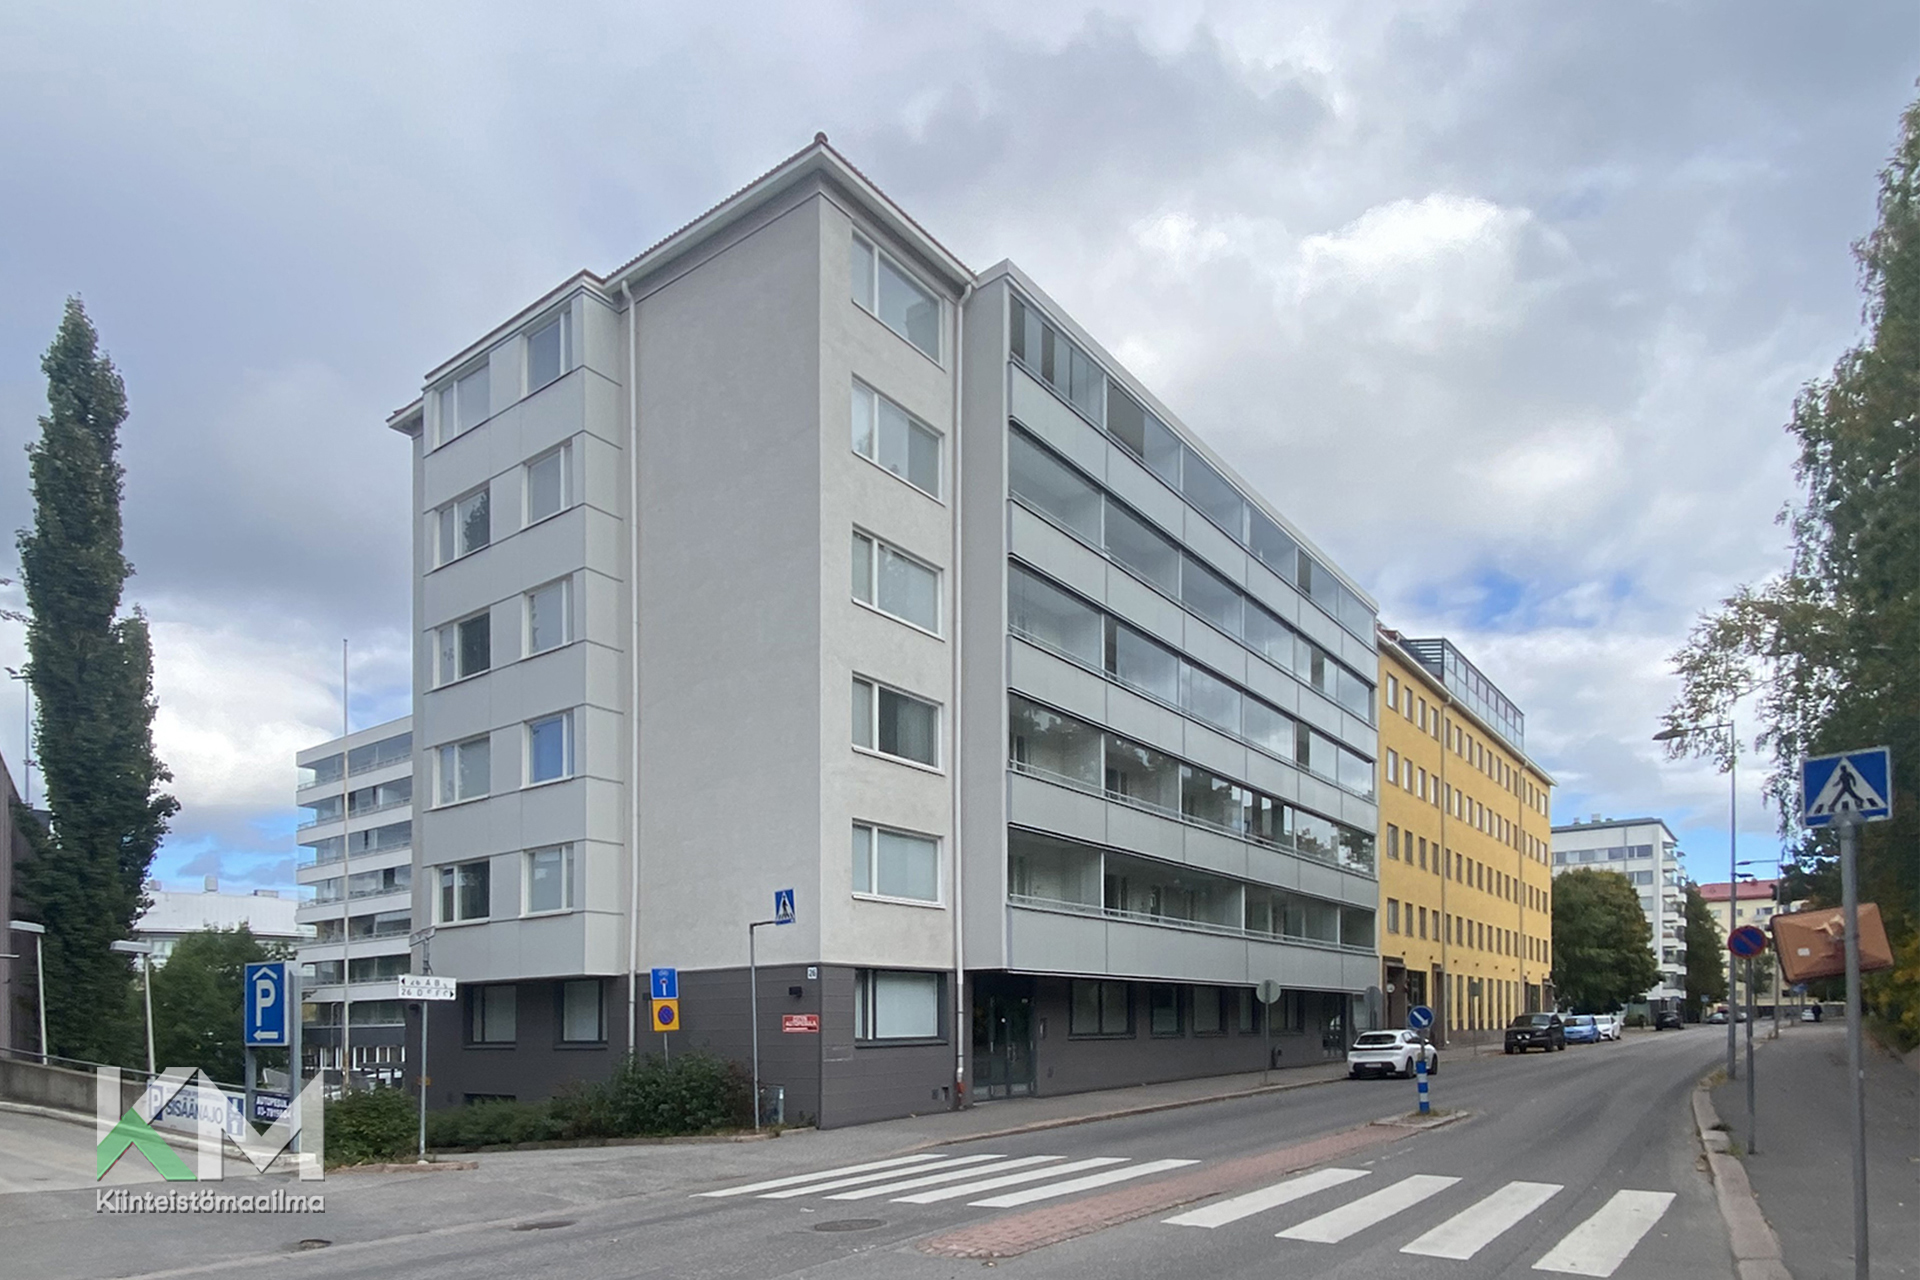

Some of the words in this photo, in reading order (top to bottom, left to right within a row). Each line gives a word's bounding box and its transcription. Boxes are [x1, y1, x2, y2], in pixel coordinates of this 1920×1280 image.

[256, 980, 276, 1027] P
[401, 988, 412, 996] 26
[150, 1087, 161, 1120] P
[165, 1097, 224, 1125] SISÄÄNAJO
